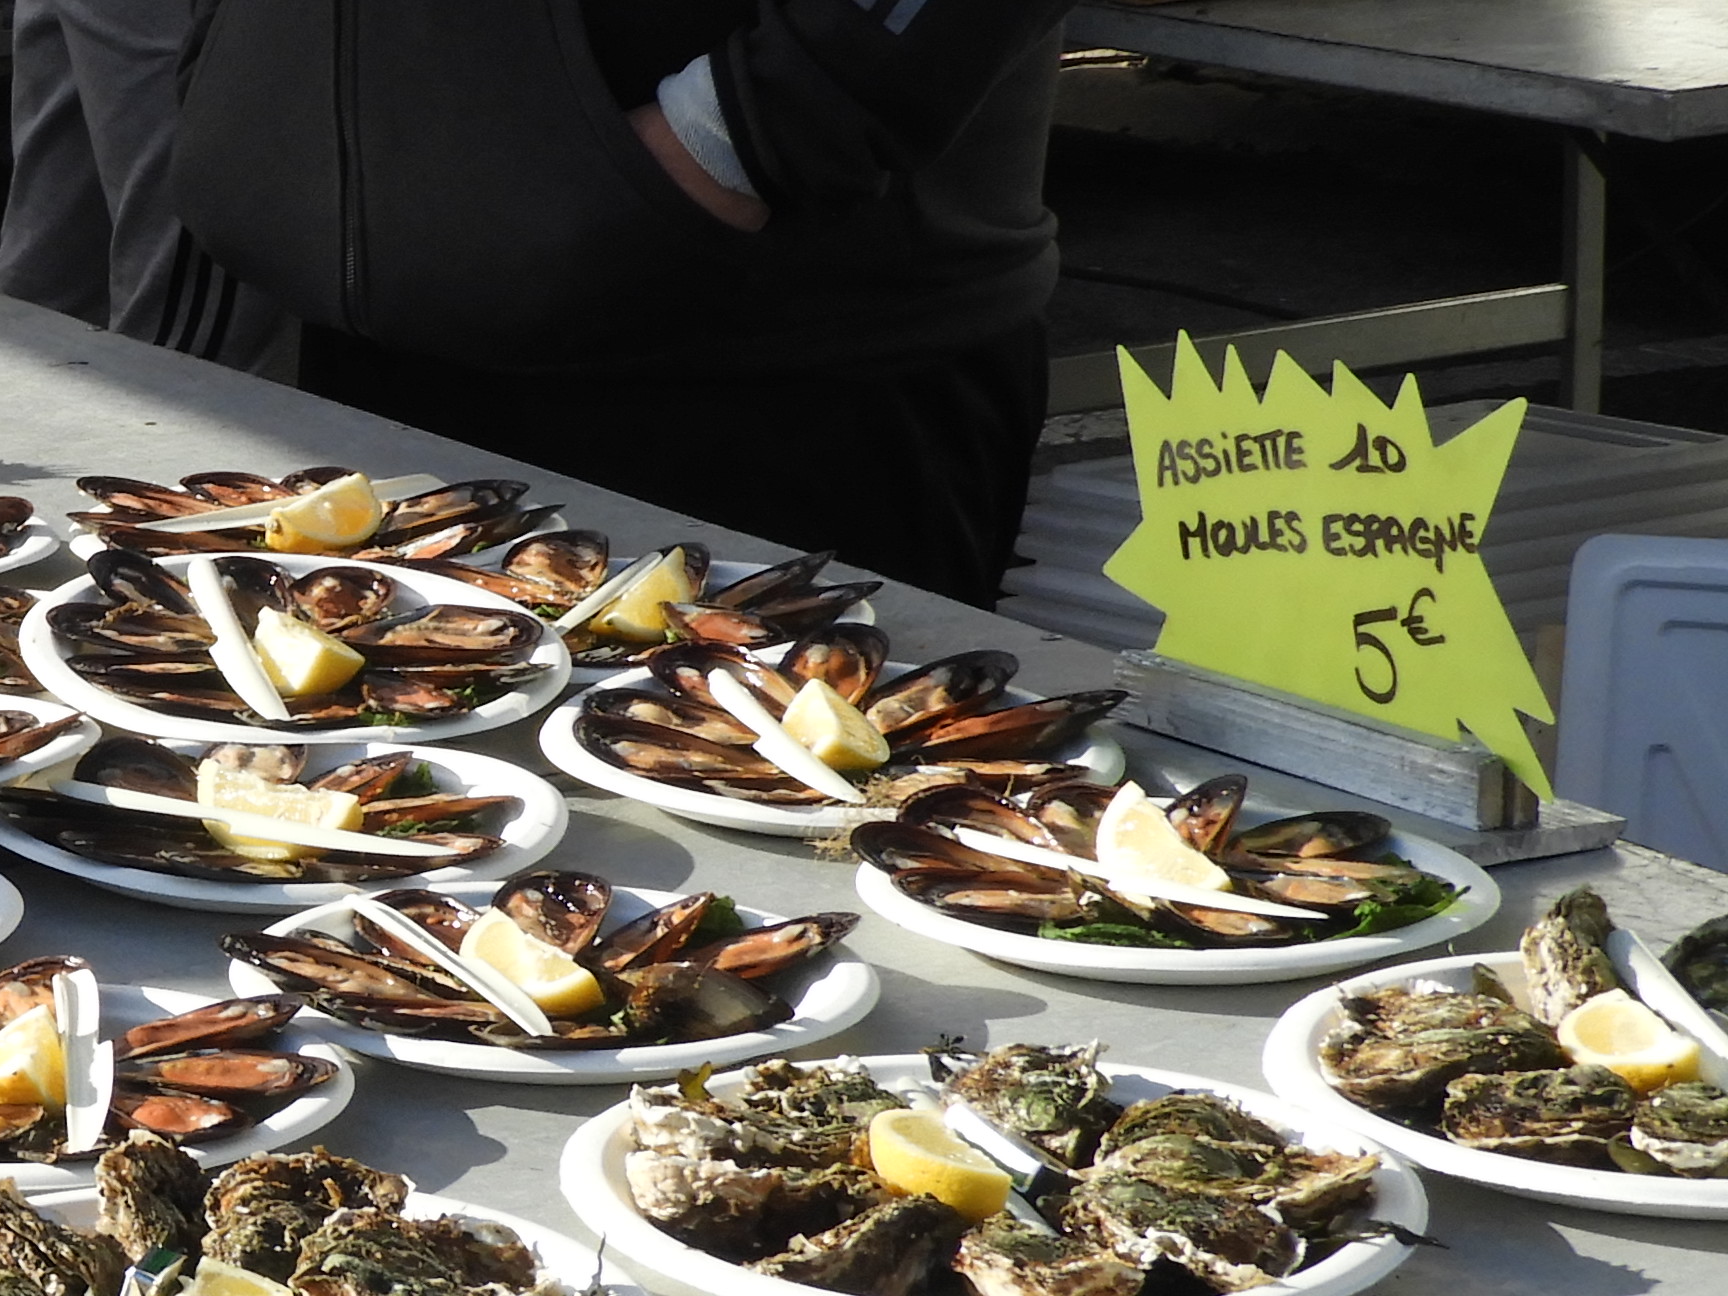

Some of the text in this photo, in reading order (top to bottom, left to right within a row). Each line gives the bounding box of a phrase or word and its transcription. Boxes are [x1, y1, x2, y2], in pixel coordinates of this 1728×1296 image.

[1329, 423, 1407, 474] 10
[1178, 510, 1479, 574] MOULES ESPAGNE
[1352, 586, 1447, 704] 5€
